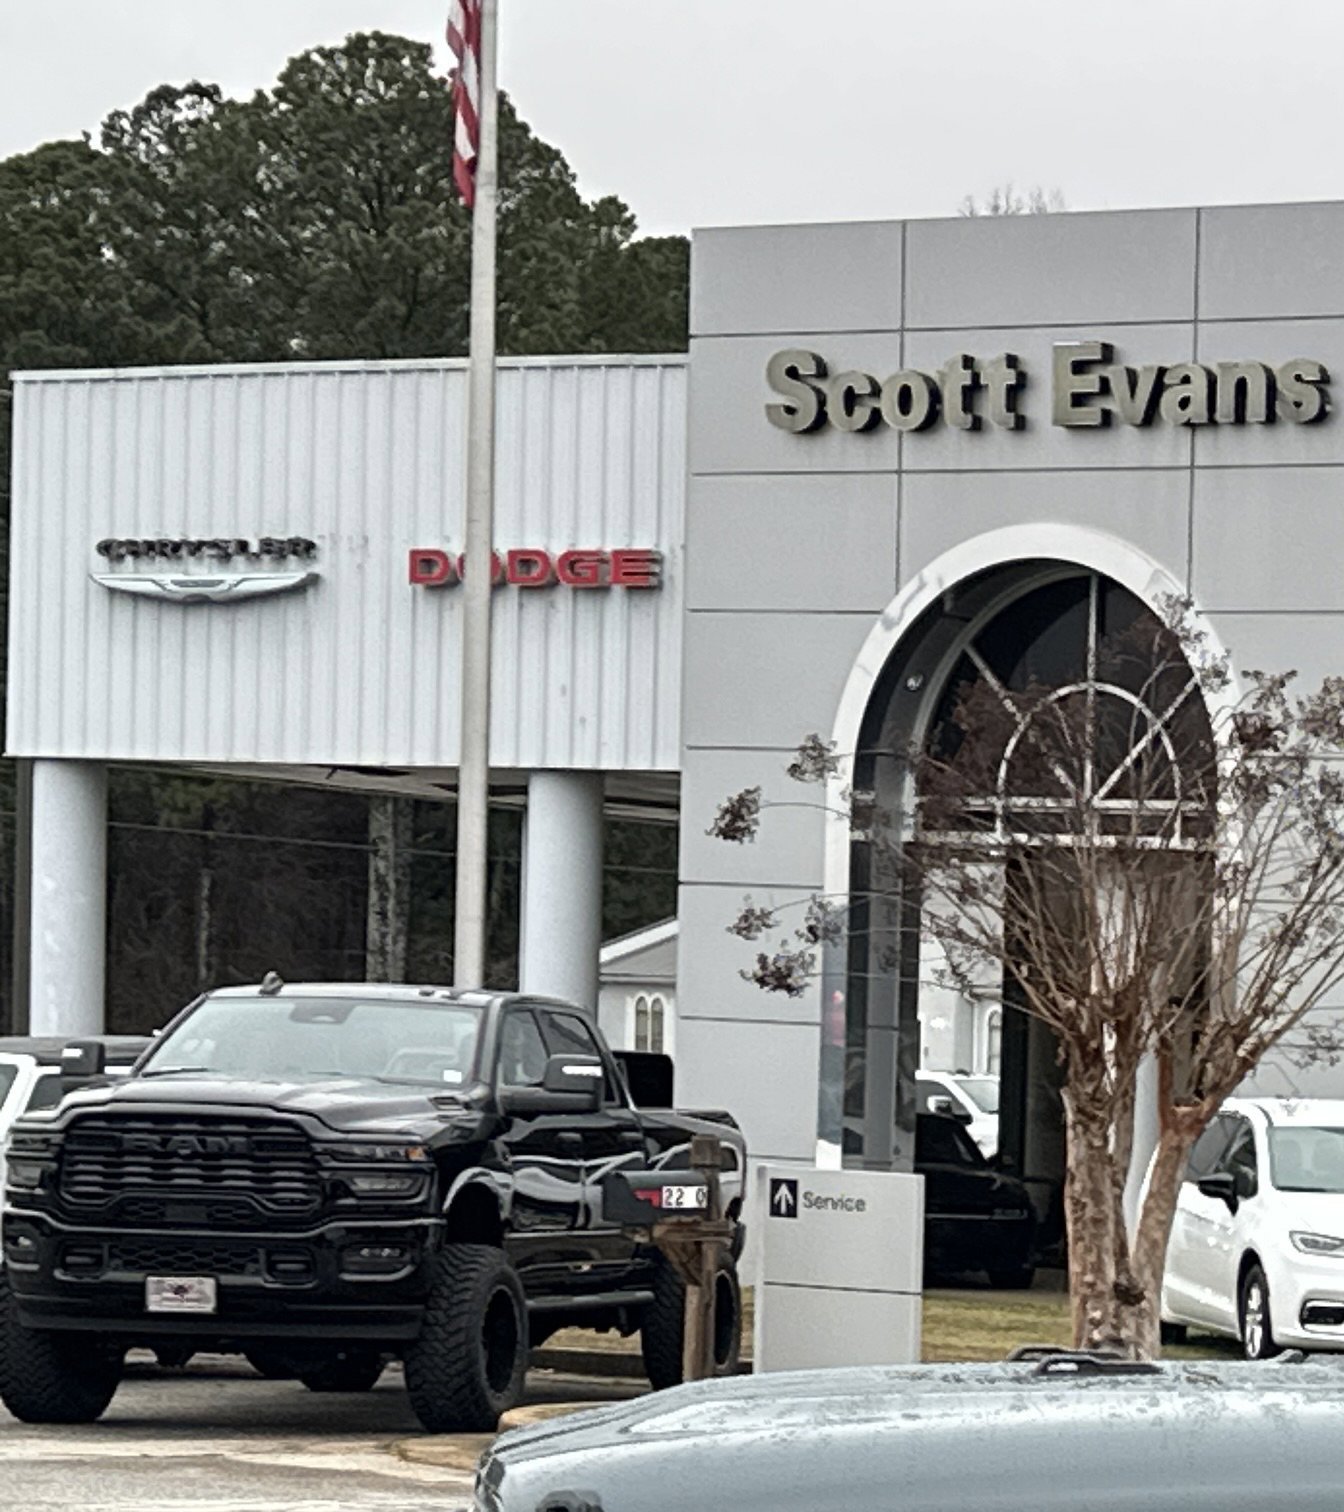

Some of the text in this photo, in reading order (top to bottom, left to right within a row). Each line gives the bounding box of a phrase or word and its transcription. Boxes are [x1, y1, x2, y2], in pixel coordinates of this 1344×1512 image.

[765, 341, 1331, 432] Scott Evans
[802, 1190, 866, 1212] Service
